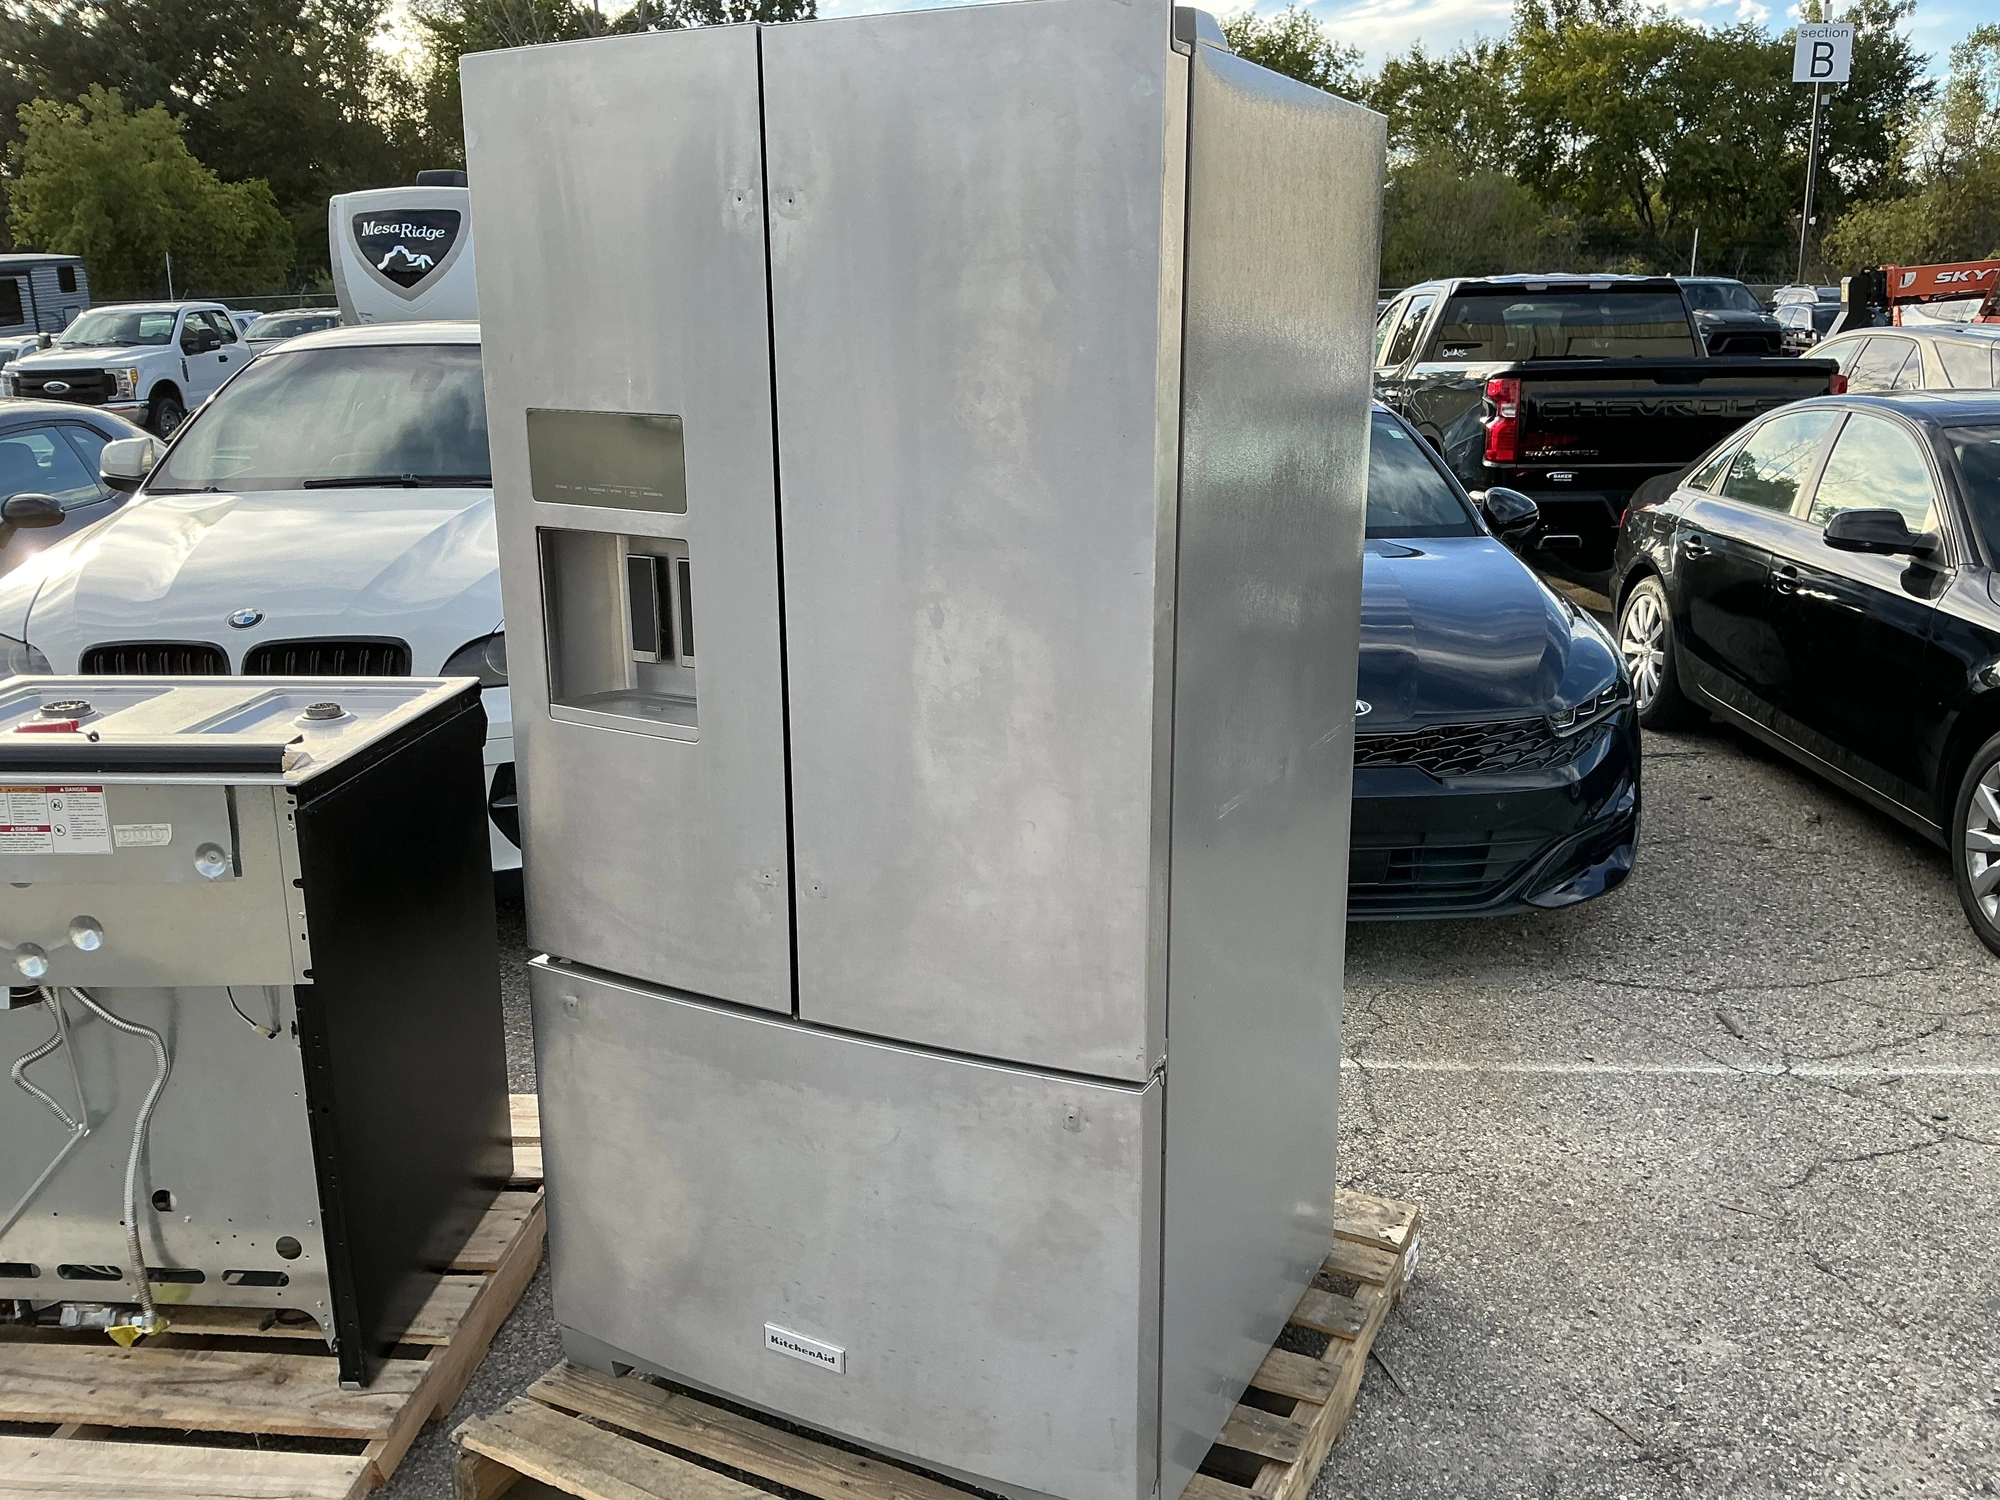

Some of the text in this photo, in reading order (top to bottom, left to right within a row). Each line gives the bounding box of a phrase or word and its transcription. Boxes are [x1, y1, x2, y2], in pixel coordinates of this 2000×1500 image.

[1801, 27, 1849, 38] section
[1810, 42, 1834, 78] B
[770, 1335, 835, 1364] KitchenAid
